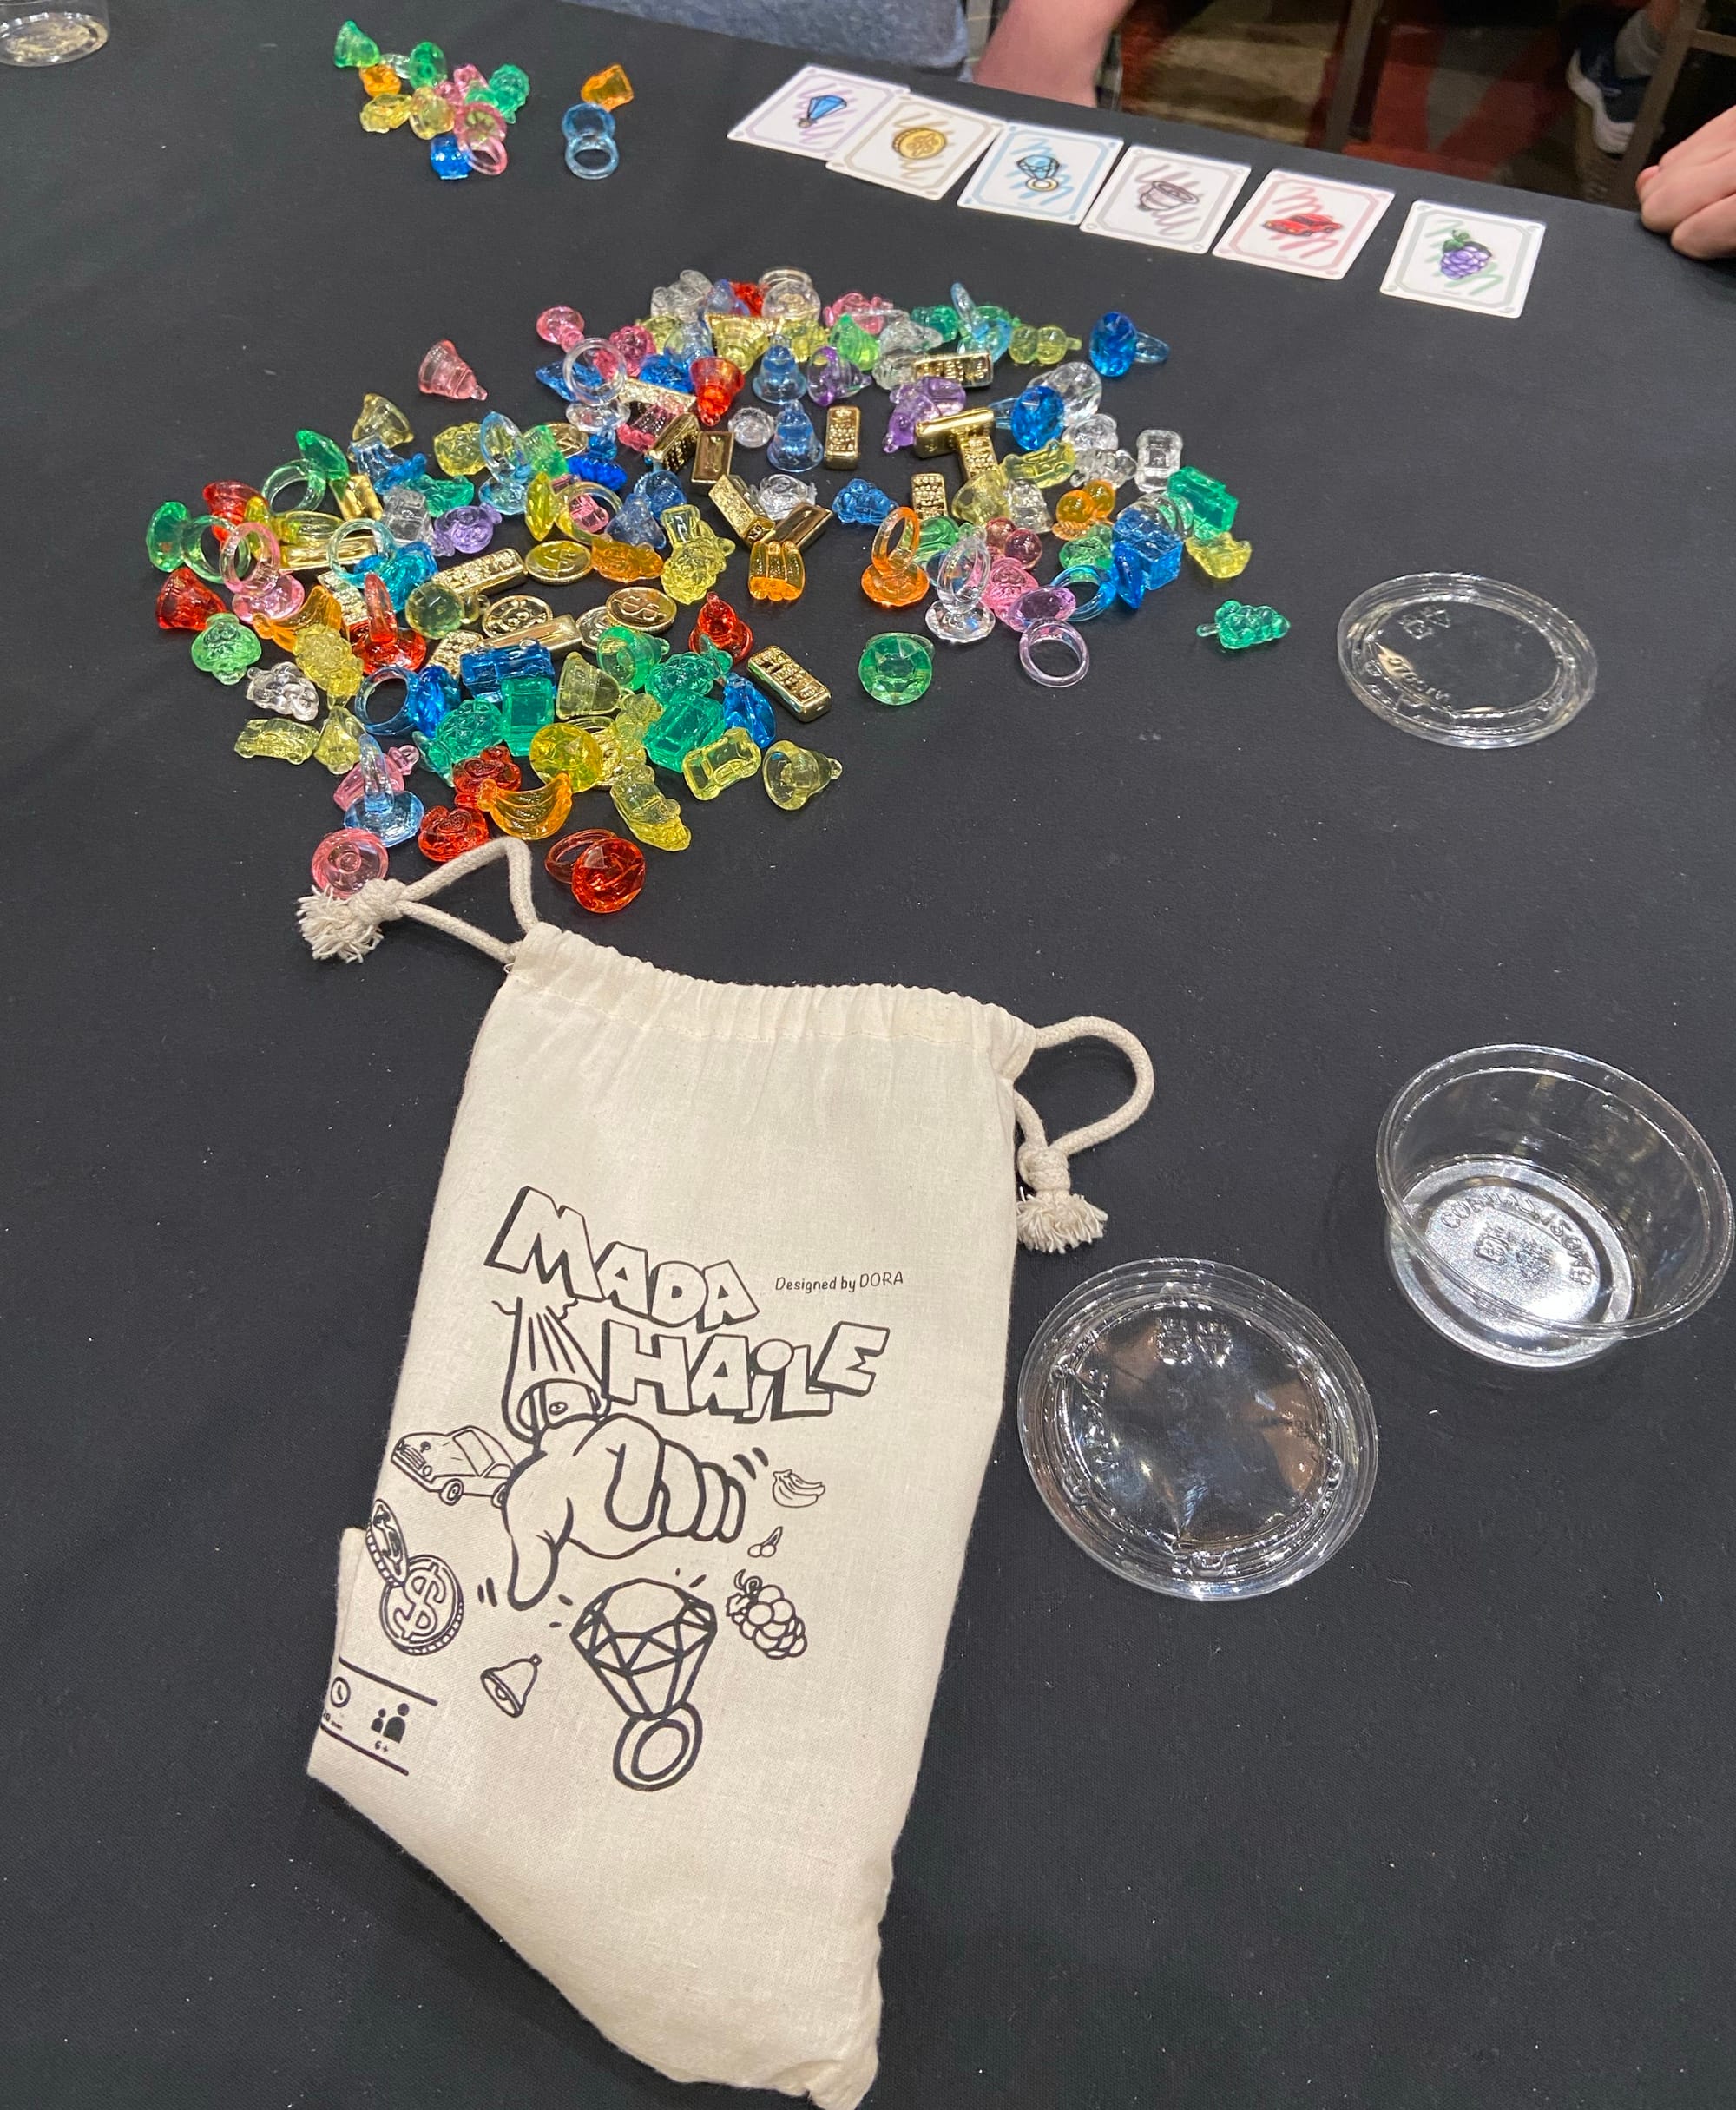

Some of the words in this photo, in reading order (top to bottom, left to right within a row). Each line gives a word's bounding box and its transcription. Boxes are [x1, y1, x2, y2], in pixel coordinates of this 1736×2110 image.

[483, 1186, 760, 1334] MADA
[775, 1276, 838, 1294] Designed
[840, 1275, 856, 1292] by
[859, 1271, 904, 1288] DORA
